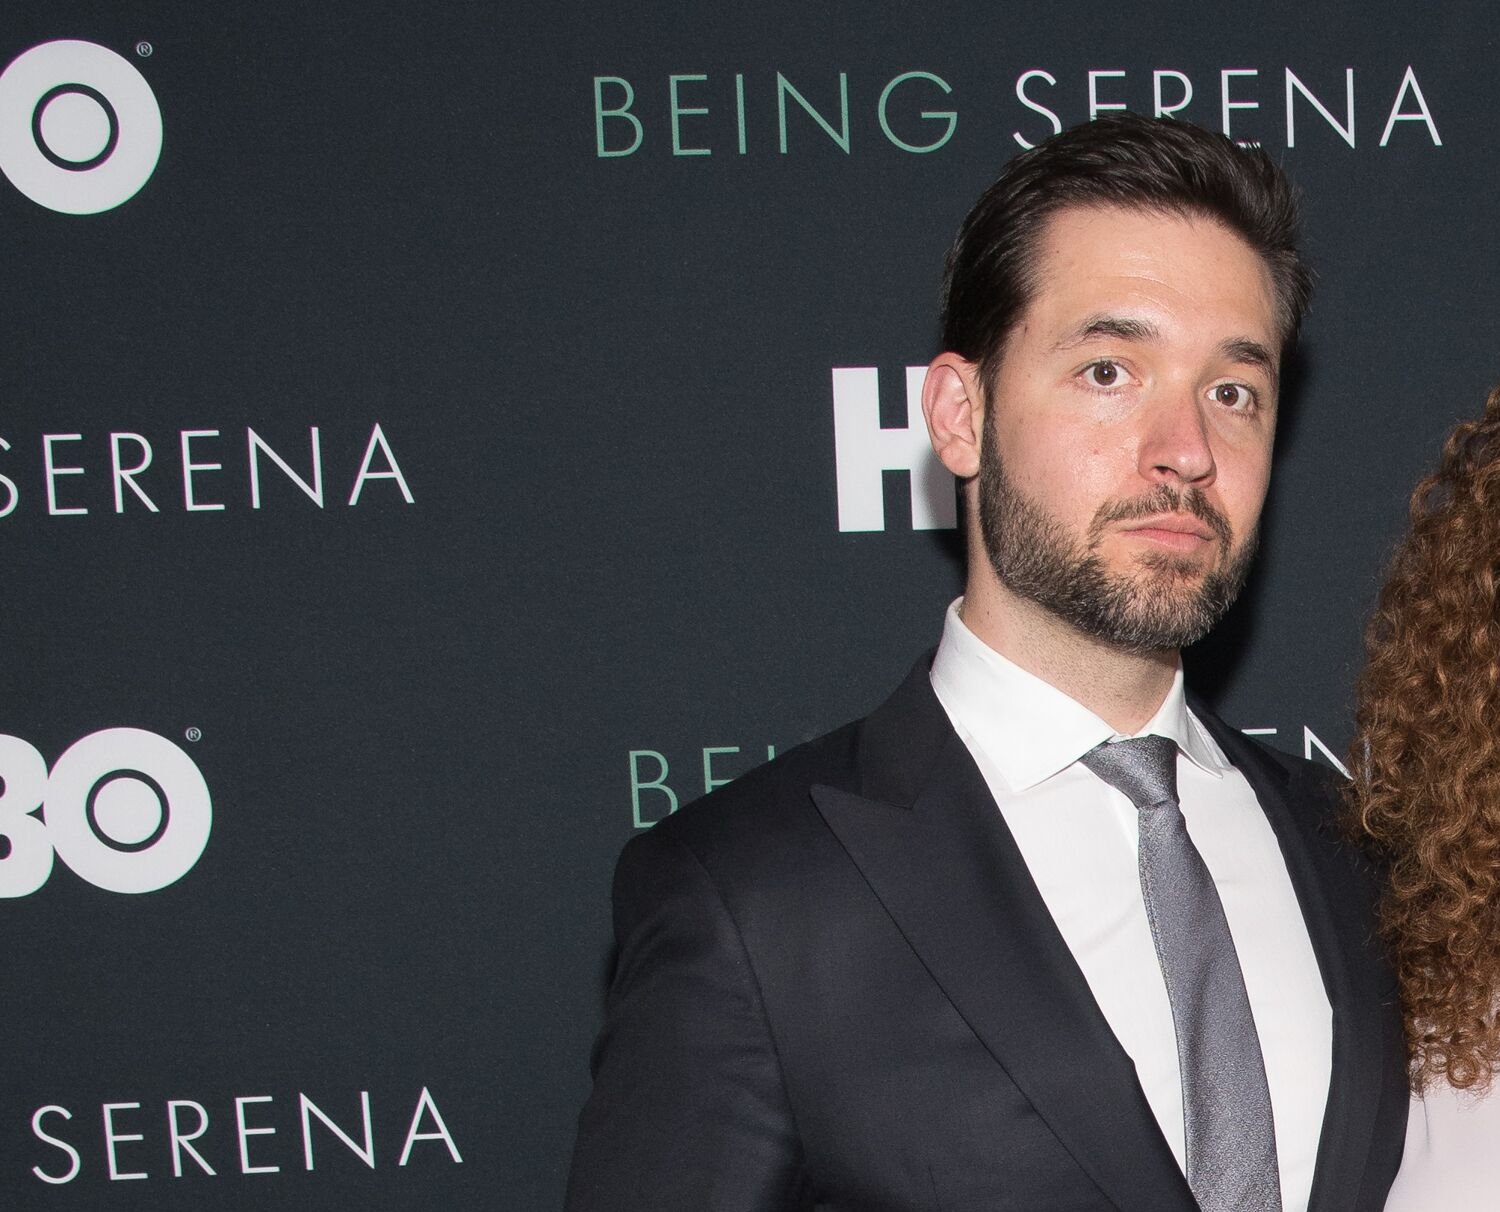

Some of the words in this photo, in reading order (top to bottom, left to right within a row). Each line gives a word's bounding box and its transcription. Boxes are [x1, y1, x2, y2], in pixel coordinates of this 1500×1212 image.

[593, 70, 958, 158] BEING
[1013, 65, 1443, 150] SERENA
[628, 744, 776, 829] BE
[31, 1085, 463, 1185] SERENA
